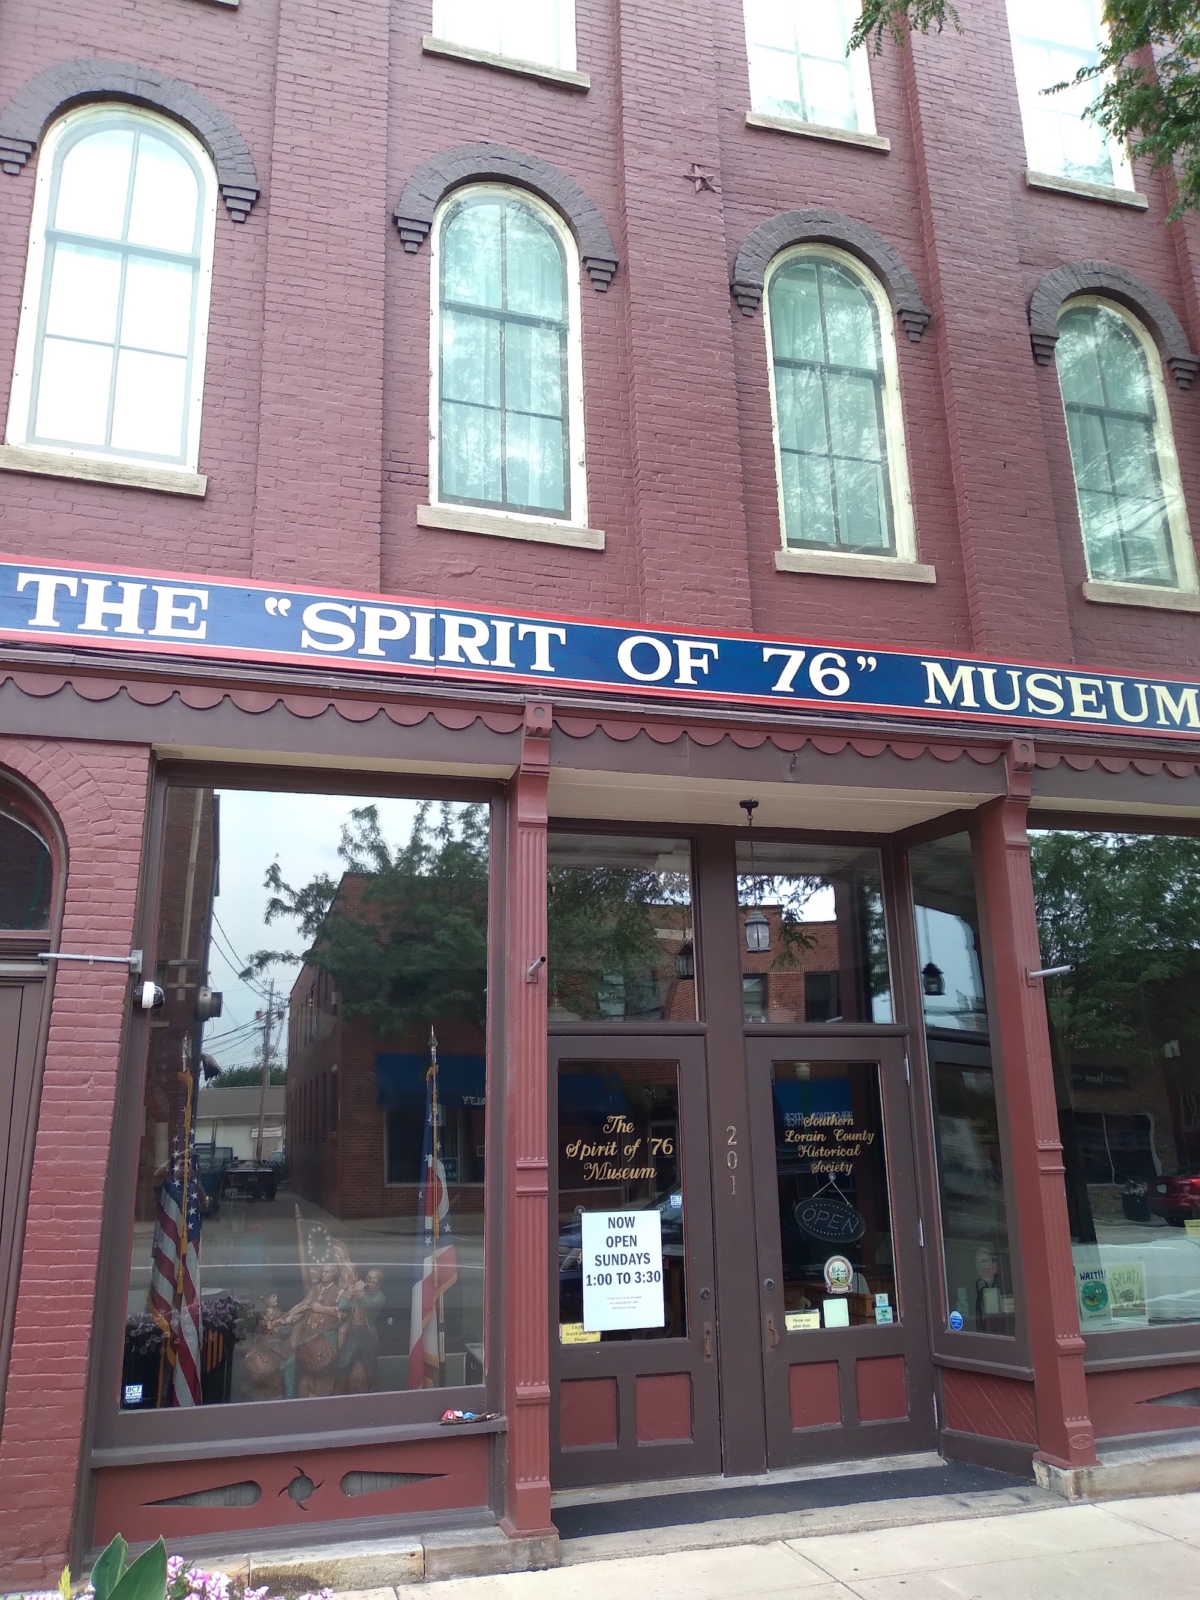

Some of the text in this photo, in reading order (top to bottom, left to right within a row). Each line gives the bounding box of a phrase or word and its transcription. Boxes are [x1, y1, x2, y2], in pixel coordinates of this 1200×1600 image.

[16, 572, 209, 640] THE
[264, 596, 567, 673] “SPIRIT
[616, 634, 719, 686] OF
[920, 661, 1200, 728] MUSEUM
[602, 1114, 635, 1134] The
[803, 1113, 855, 1129] Southern
[784, 1128, 875, 1145] Lorain County
[565, 1137, 674, 1163] Spirit of '76
[797, 1144, 862, 1158] Historical
[583, 1162, 658, 1181] Museum
[810, 1159, 854, 1176] Society
[607, 1216, 636, 1229] NOW
[802, 1207, 860, 1234] OPEN
[605, 1234, 638, 1248] OPEN
[594, 1252, 651, 1267] SUNDAYS
[585, 1270, 662, 1287] 1:00 TO 3:30
[1079, 1269, 1107, 1281] WAIT!!!
[1112, 1269, 1140, 1288] SPLAT!
